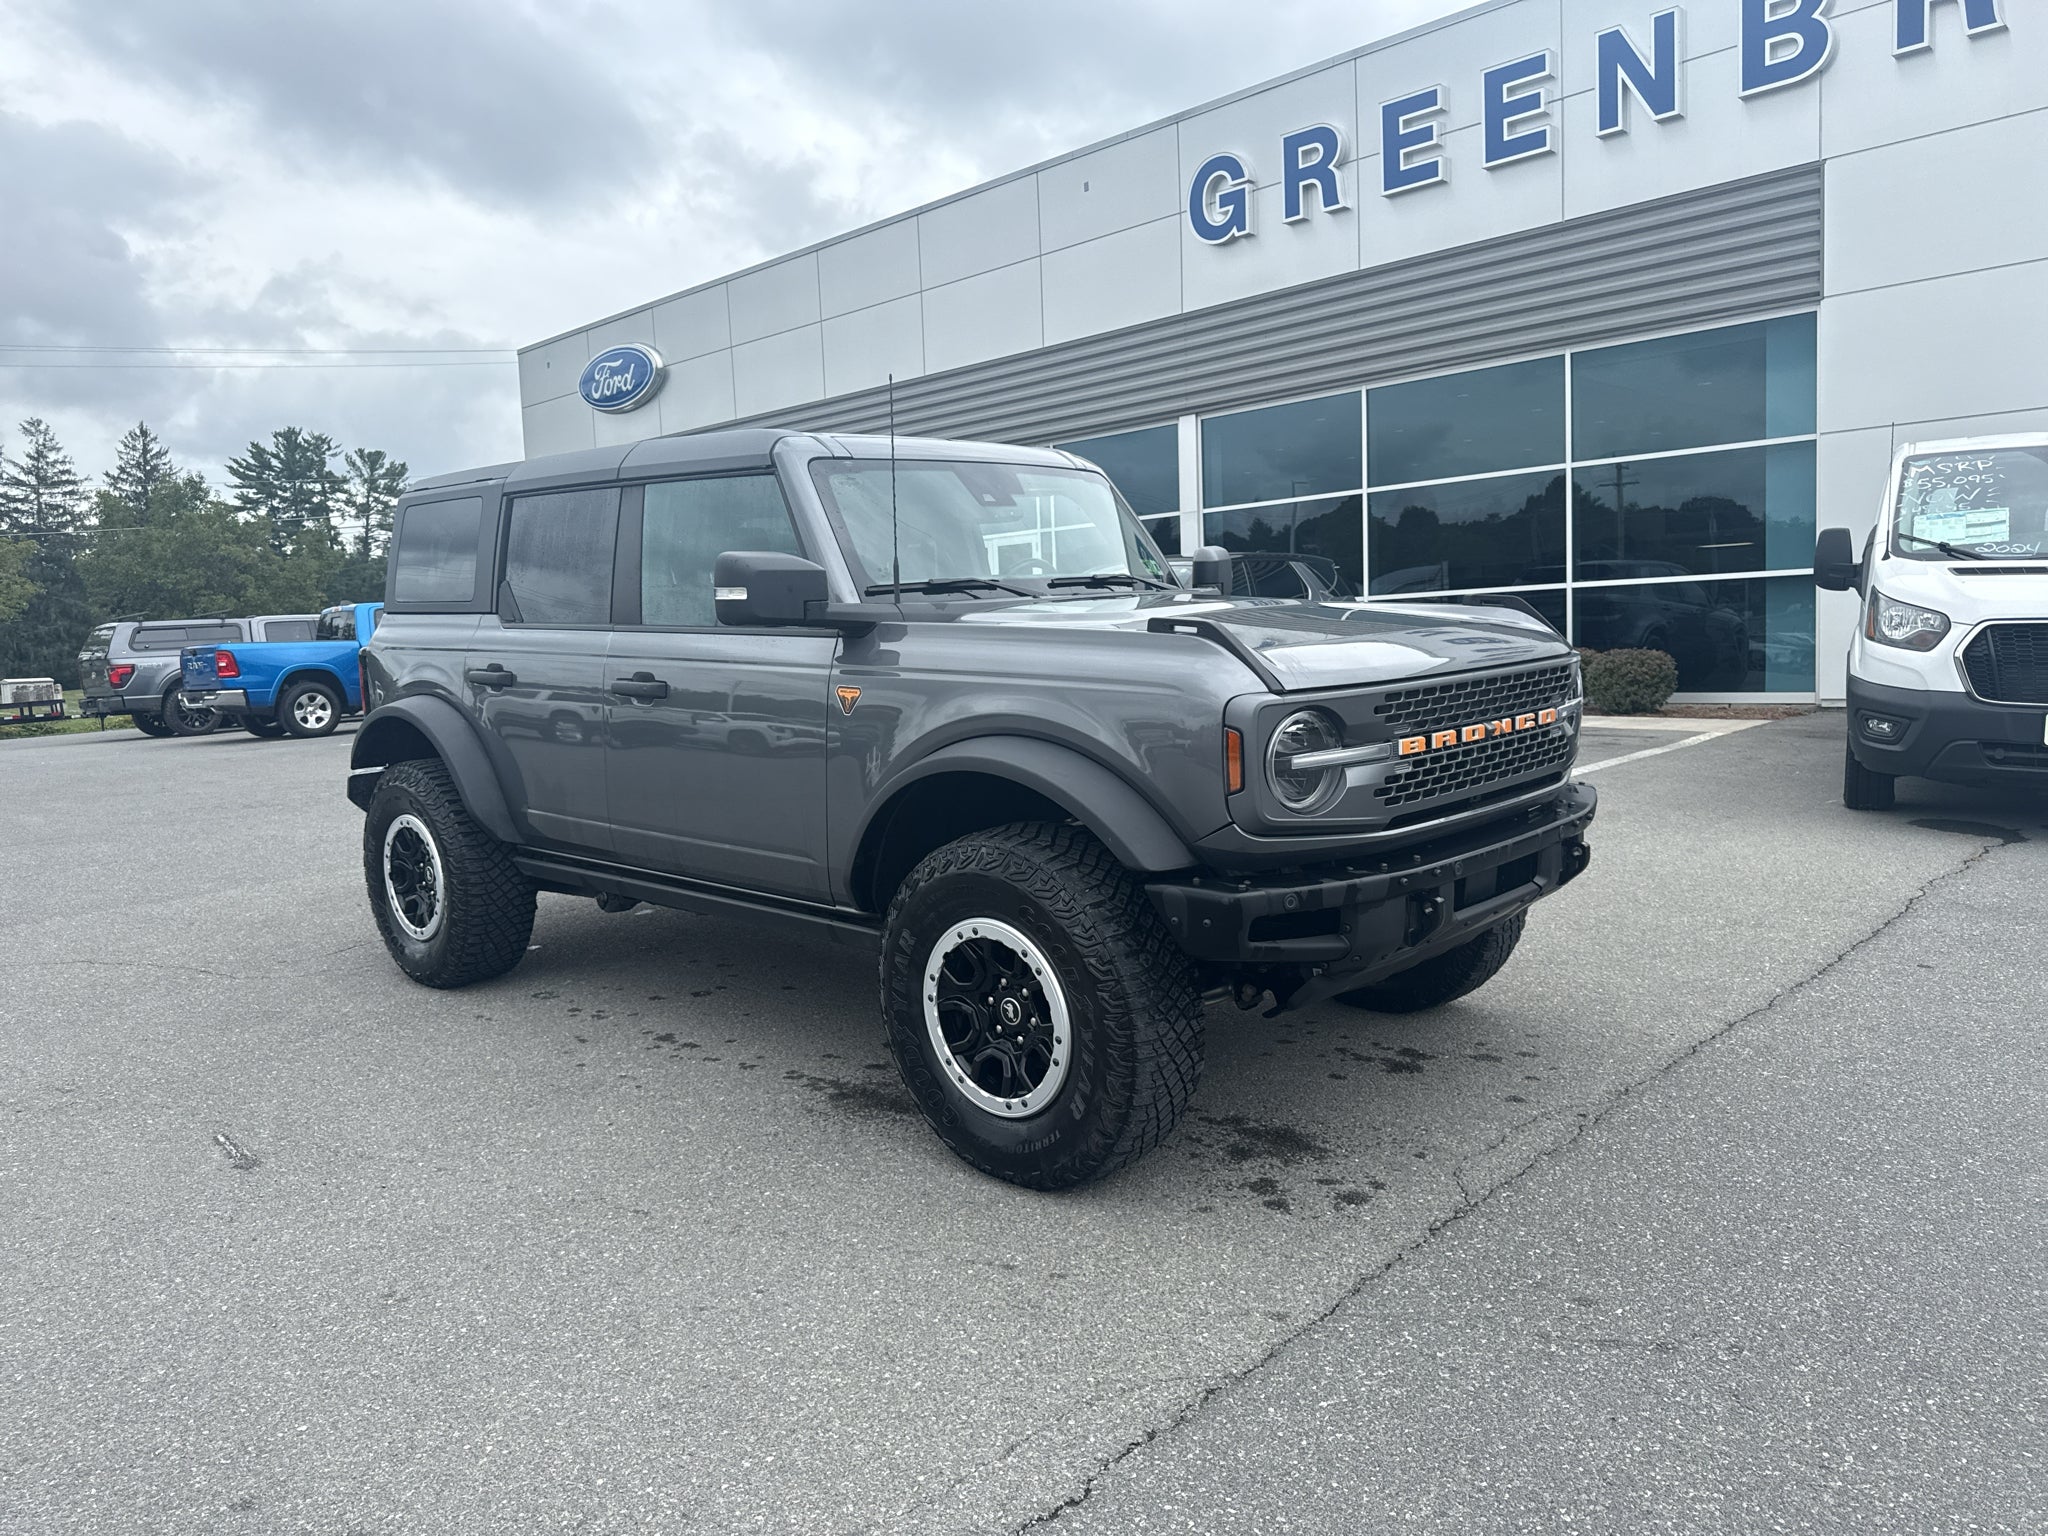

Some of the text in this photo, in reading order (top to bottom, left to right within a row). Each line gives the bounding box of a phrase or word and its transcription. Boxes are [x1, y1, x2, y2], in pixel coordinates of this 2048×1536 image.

[591, 358, 635, 399] Ford
[1909, 459, 1993, 478] MSRP
[1903, 473, 1994, 490] $55,095
[1903, 487, 1982, 505] NOW
[1975, 541, 2041, 556] 2024
[1398, 708, 1556, 755] BRONCO
